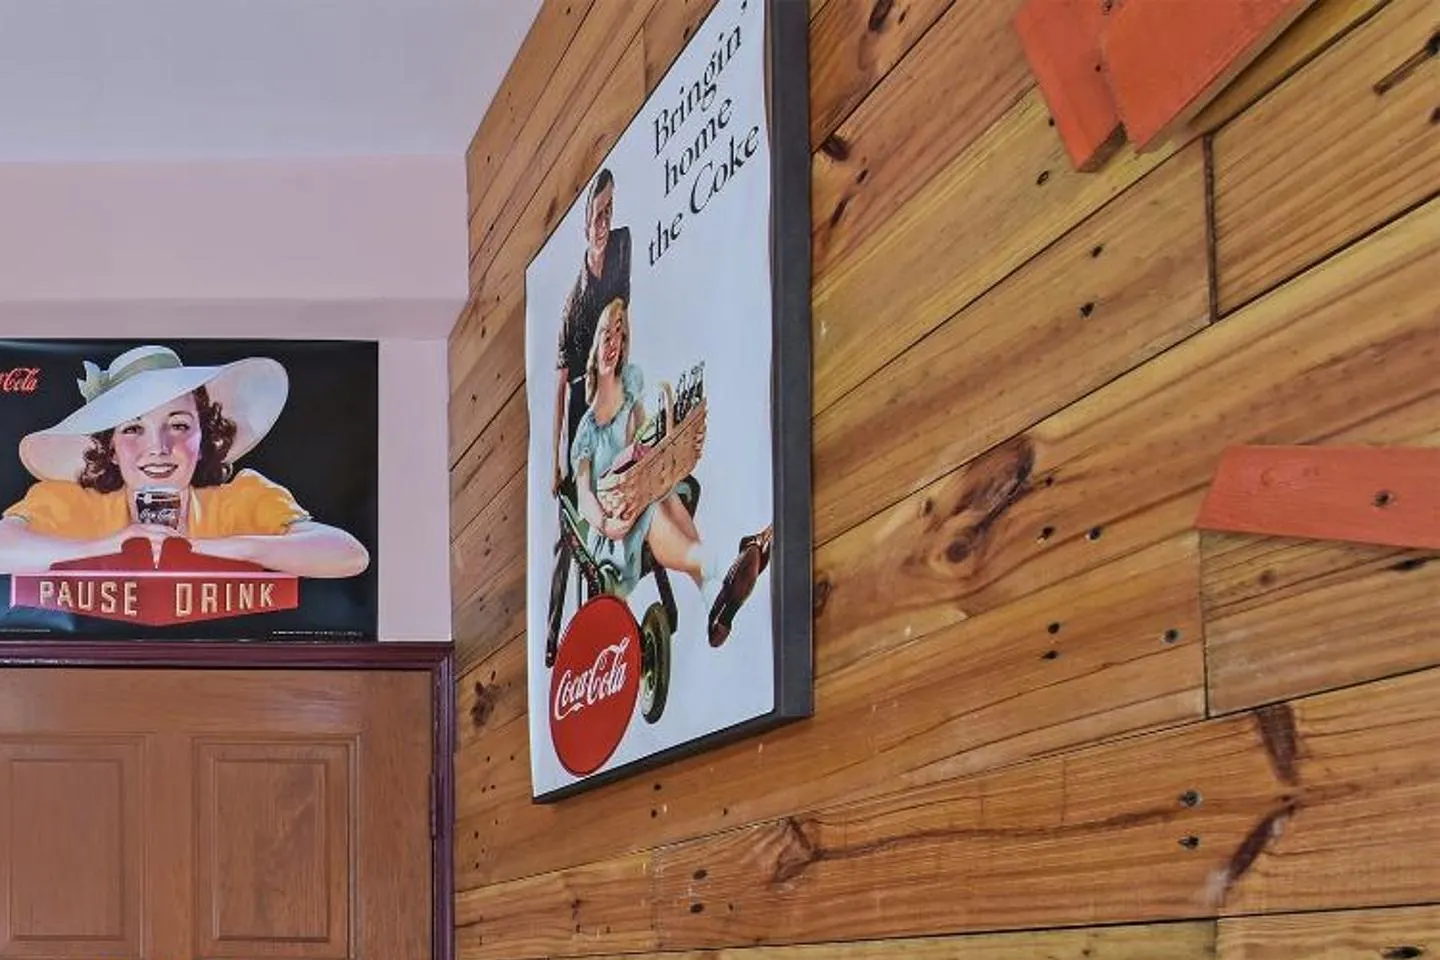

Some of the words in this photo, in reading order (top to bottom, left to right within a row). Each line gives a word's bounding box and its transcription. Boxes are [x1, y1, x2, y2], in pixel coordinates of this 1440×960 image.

[664, 98, 733, 197] home
[648, 212, 684, 267] the
[690, 125, 760, 215] Coke
[39, 581, 139, 617] PAUSE
[175, 582, 277, 618] DRINK
[554, 636, 631, 721] Coca-Cola
